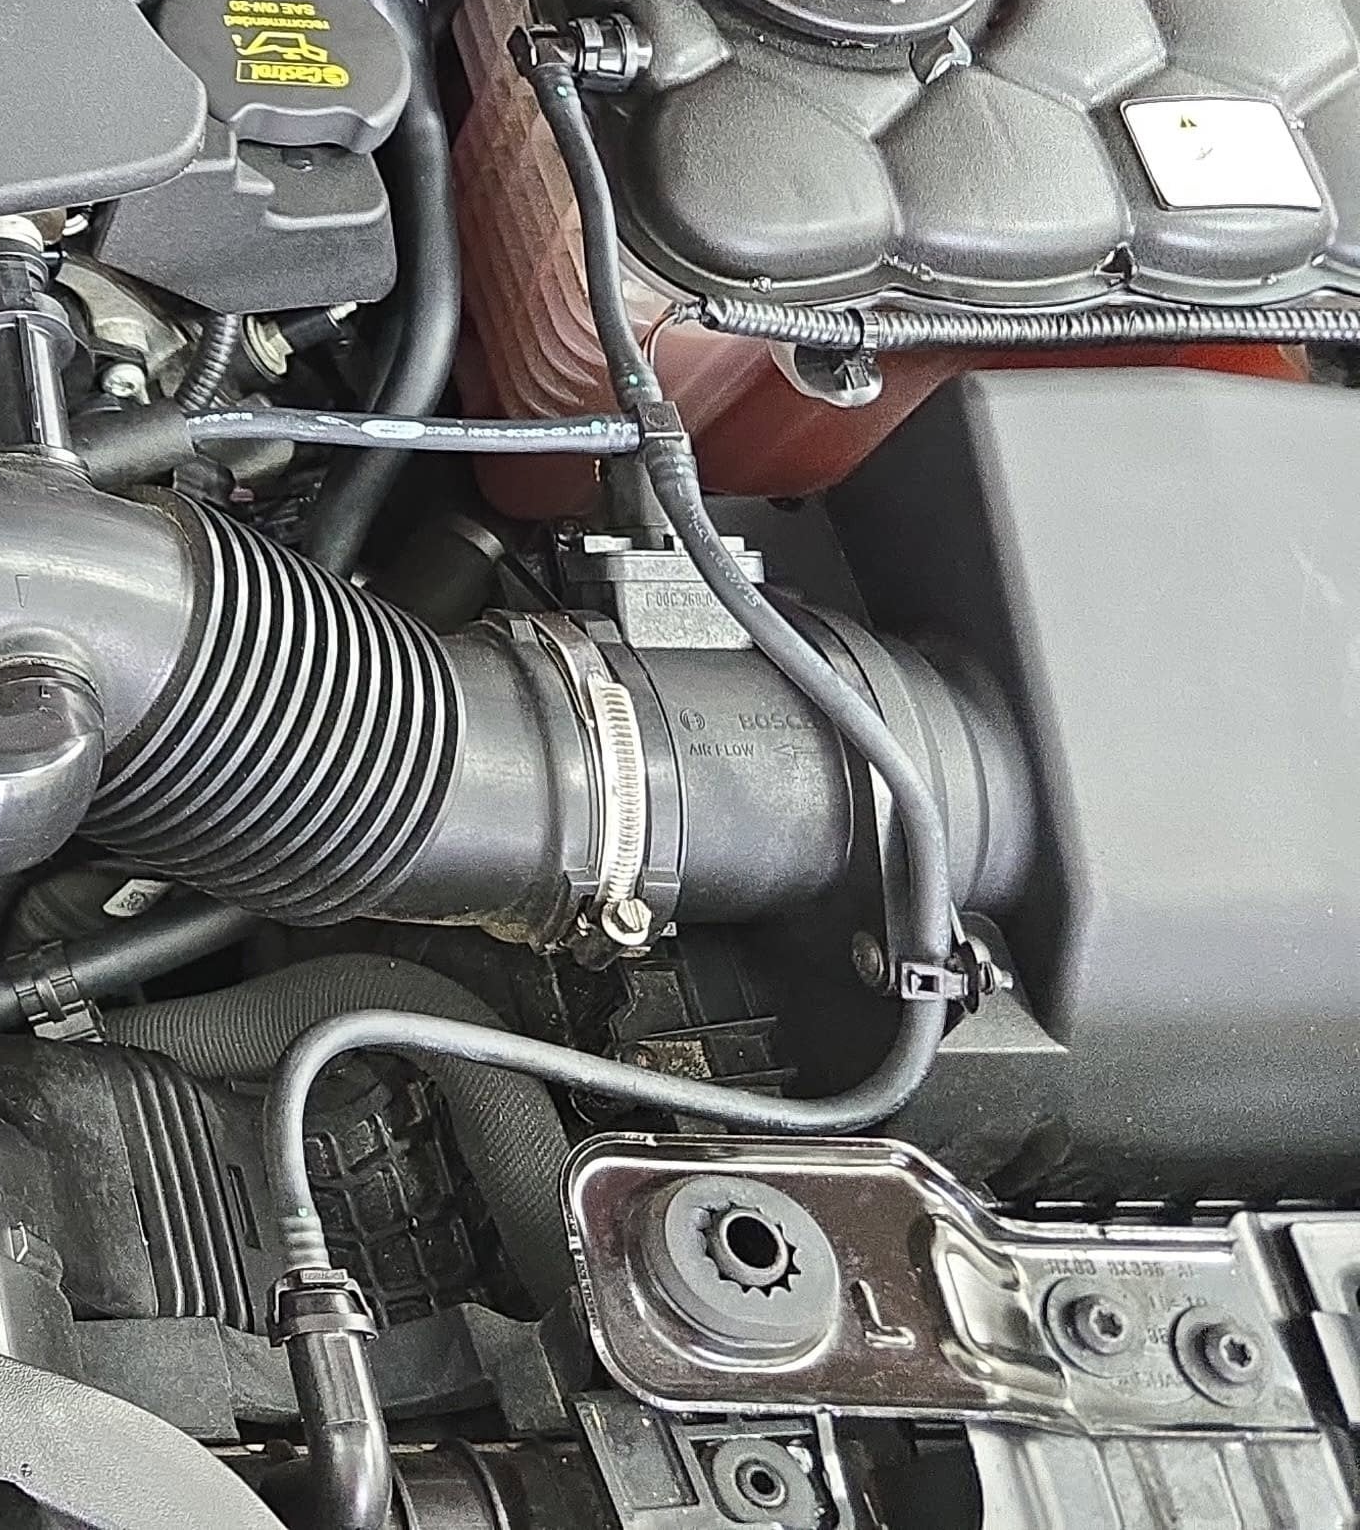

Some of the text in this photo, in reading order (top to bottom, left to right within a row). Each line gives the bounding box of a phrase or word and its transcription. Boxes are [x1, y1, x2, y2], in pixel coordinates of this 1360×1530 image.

[223, 14, 331, 31] recommended
[250, 63, 323, 83] Castrol
[689, 742, 755, 758] AIR FLOW
